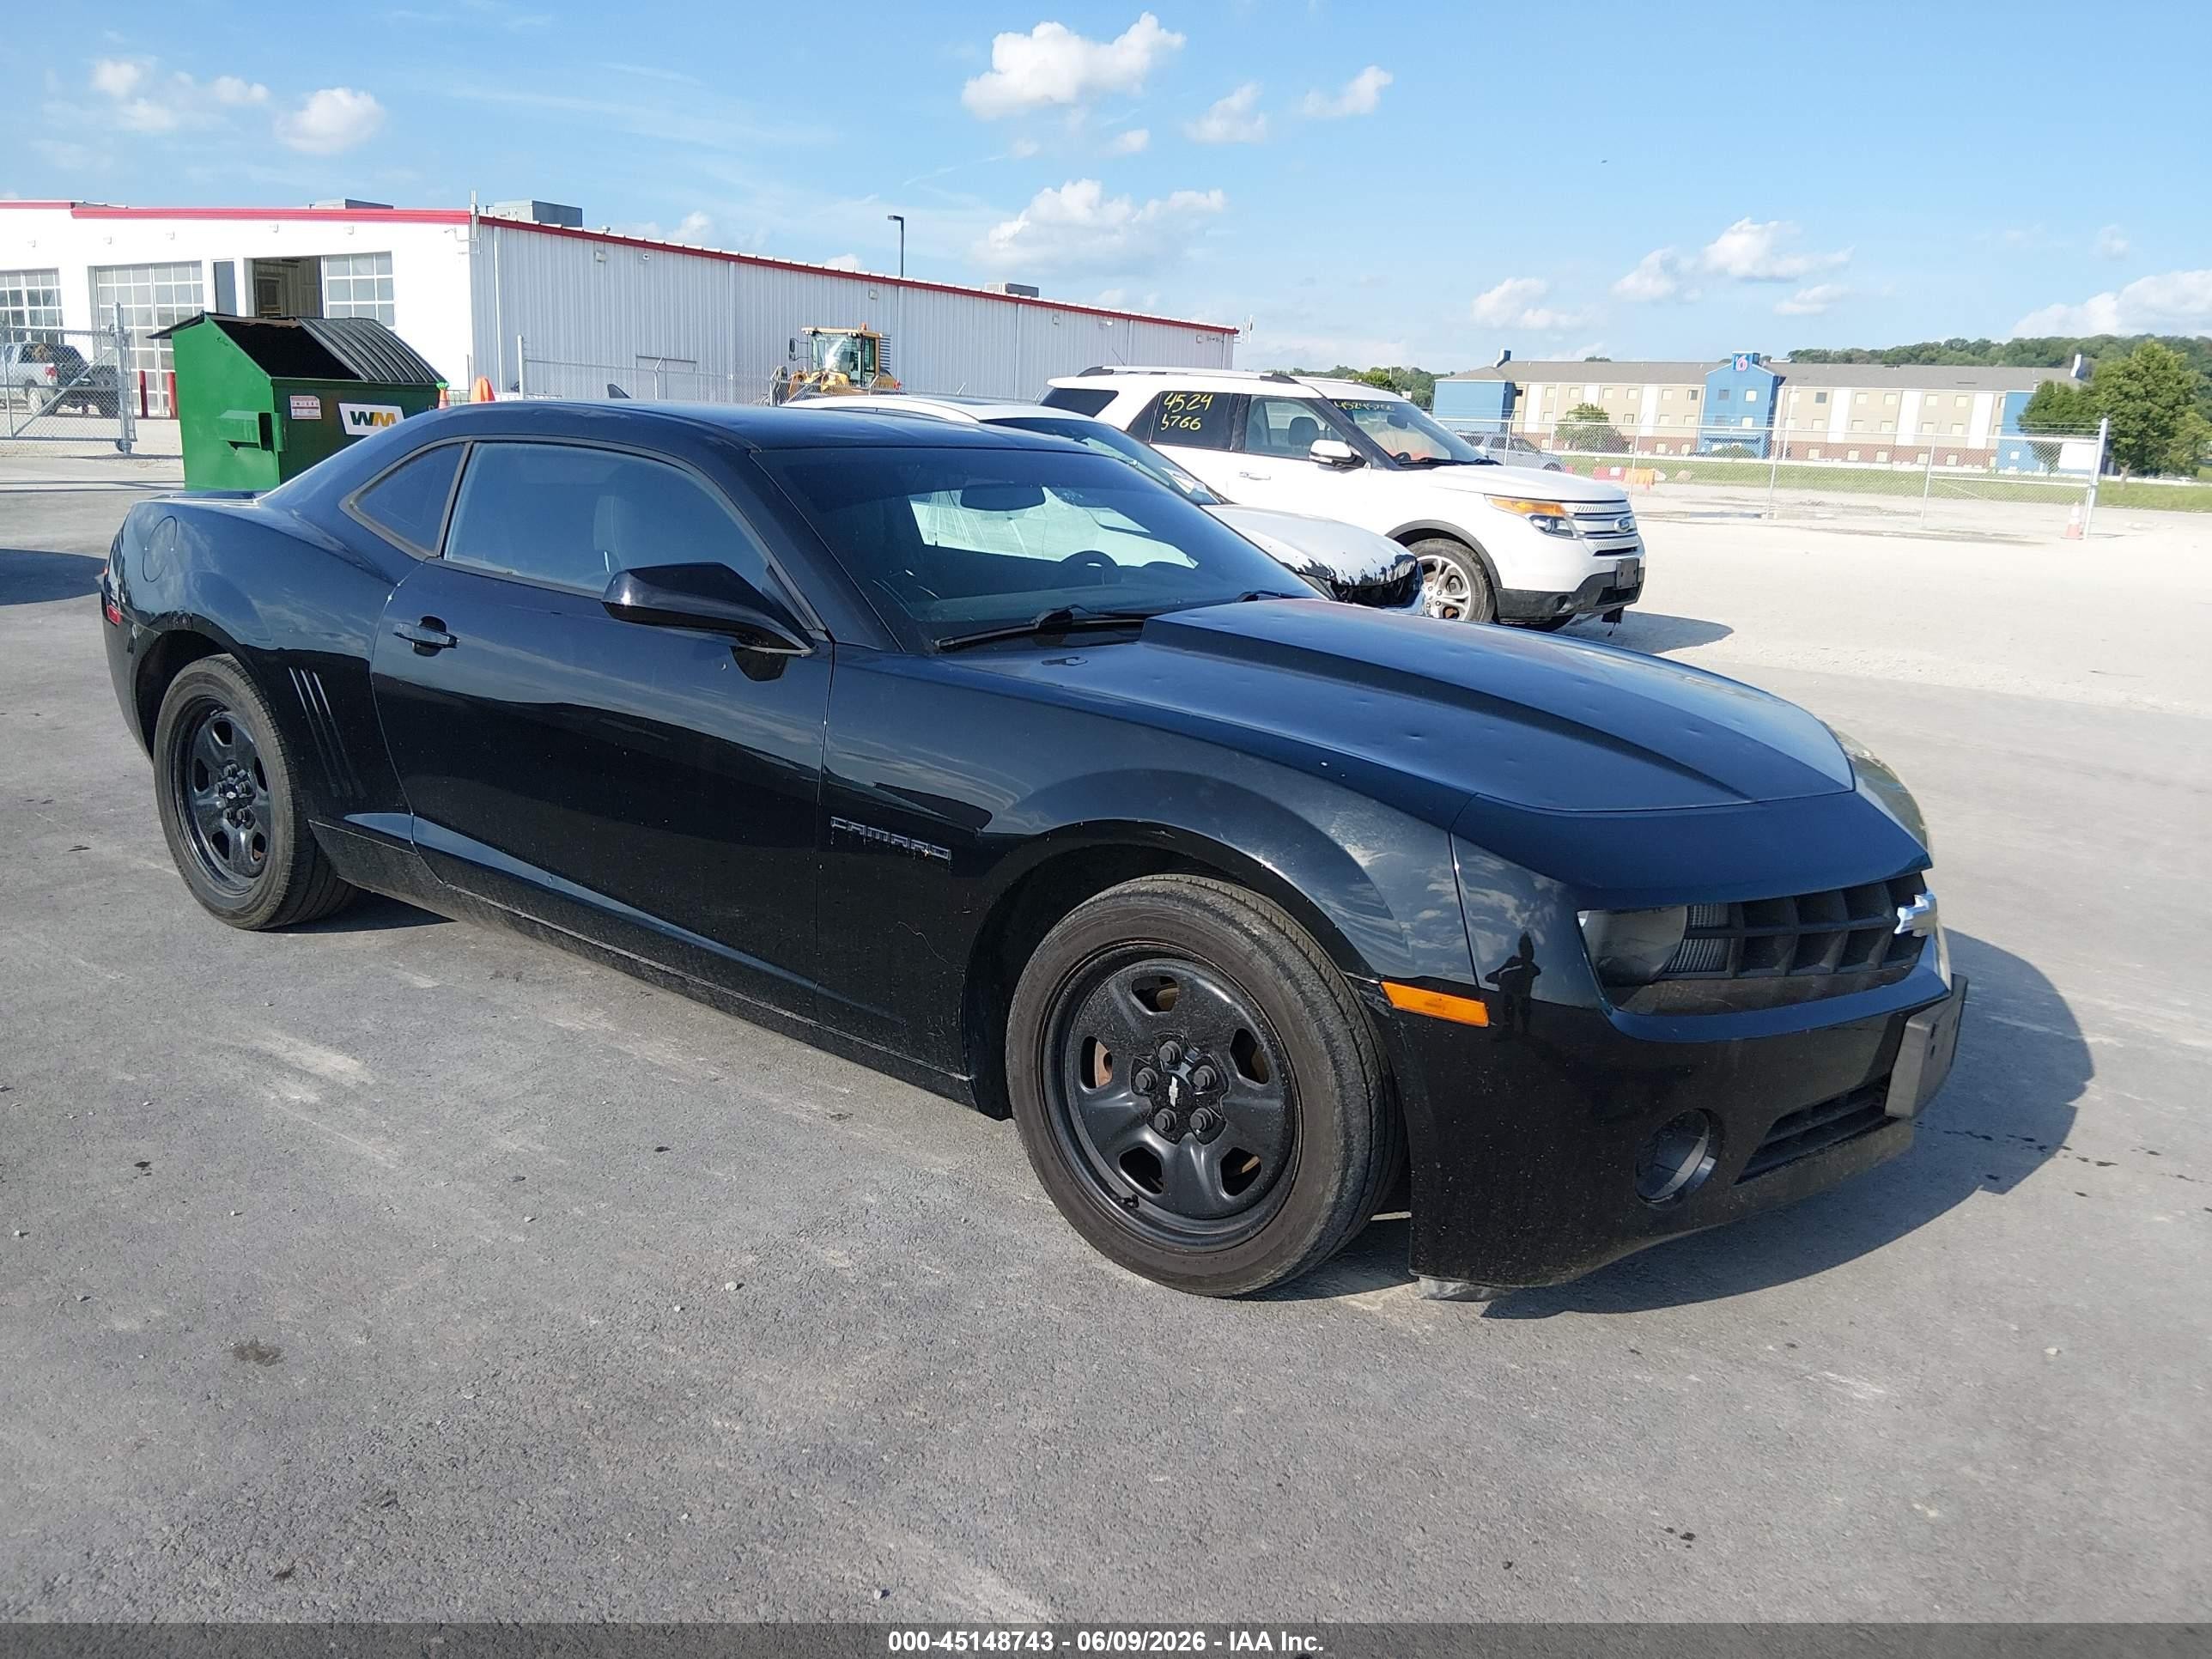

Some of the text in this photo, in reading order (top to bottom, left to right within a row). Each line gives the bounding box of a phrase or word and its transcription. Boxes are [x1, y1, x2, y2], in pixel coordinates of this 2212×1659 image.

[1164, 392, 1213, 412] 4524
[349, 410, 397, 427] WM
[1160, 413, 1201, 430] 5766
